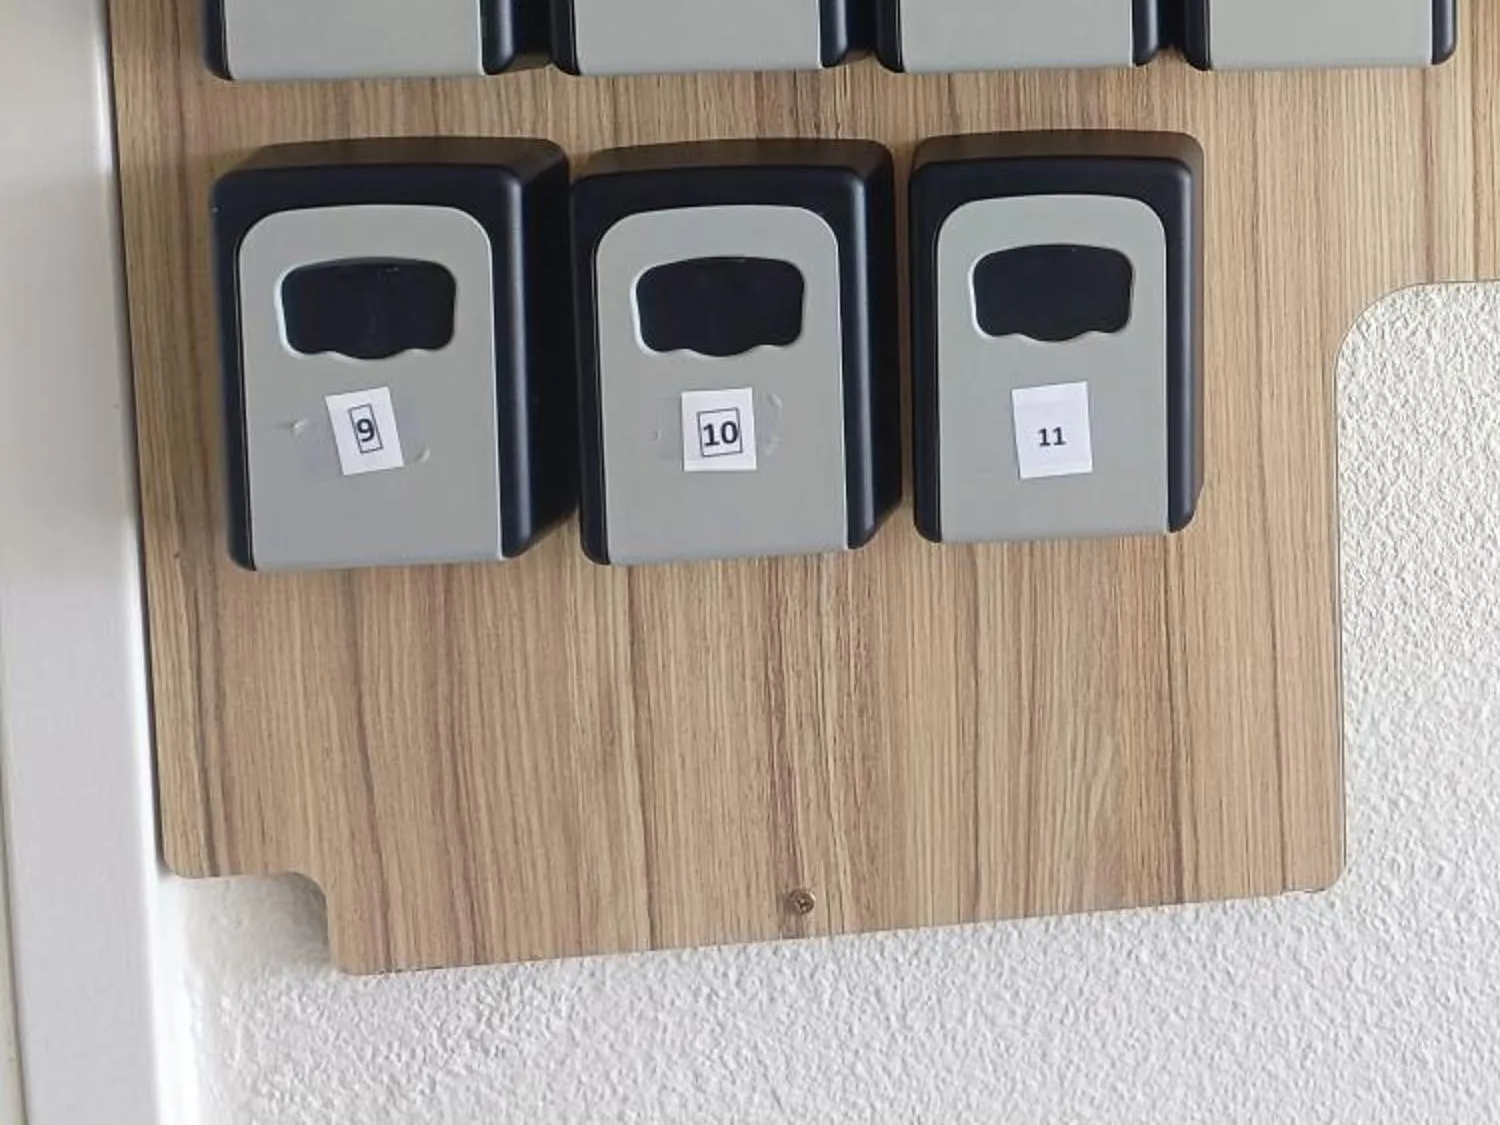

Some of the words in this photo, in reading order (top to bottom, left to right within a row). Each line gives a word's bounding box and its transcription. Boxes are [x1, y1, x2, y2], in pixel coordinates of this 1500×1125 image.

[356, 418, 375, 443] 9
[703, 420, 740, 447] 10
[1039, 426, 1065, 447] 11
